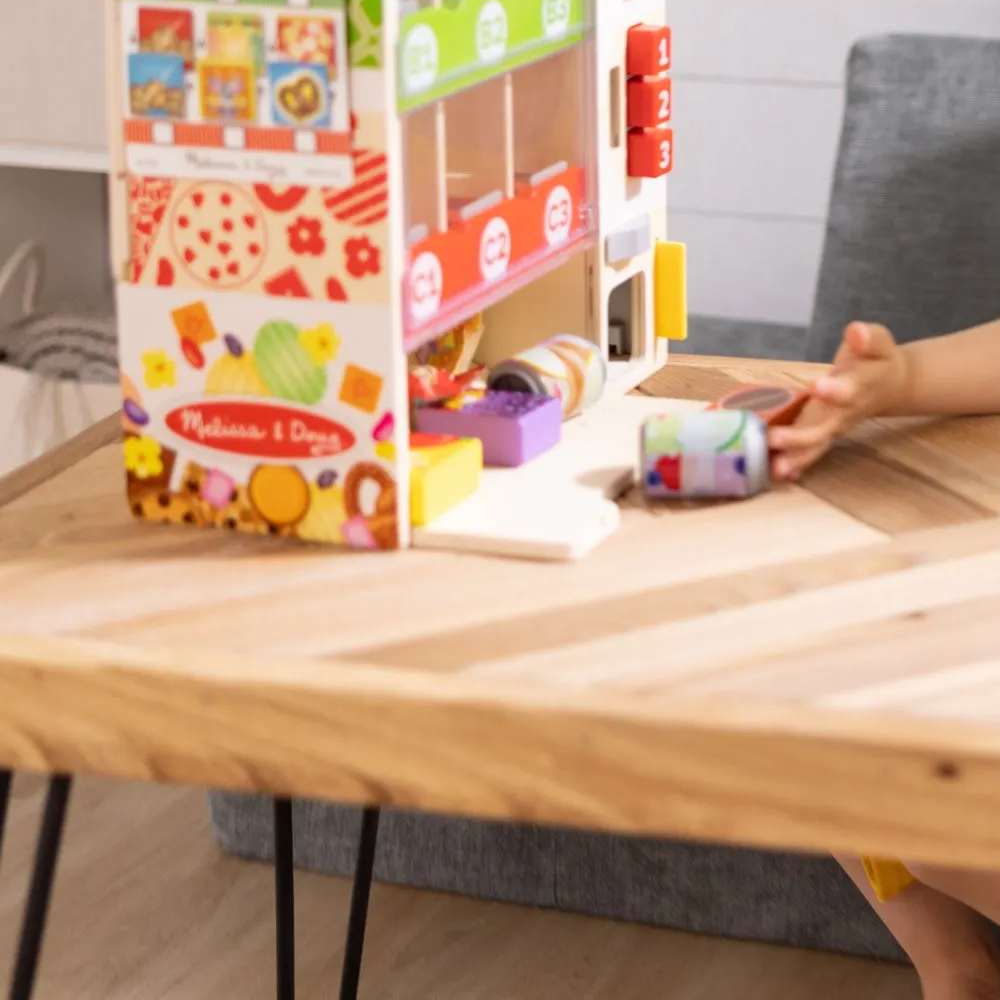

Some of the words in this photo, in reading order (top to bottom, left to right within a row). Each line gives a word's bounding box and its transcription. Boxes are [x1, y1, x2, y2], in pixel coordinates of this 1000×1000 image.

[480, 15, 506, 49] B2
[658, 38, 669, 66] 1
[658, 90, 669, 119] 2
[659, 140, 670, 169] 3
[412, 269, 438, 303] C1
[484, 232, 508, 266] C2
[548, 199, 569, 231] C3
[180, 409, 268, 441] Melissa
[290, 417, 342, 457] Doug
